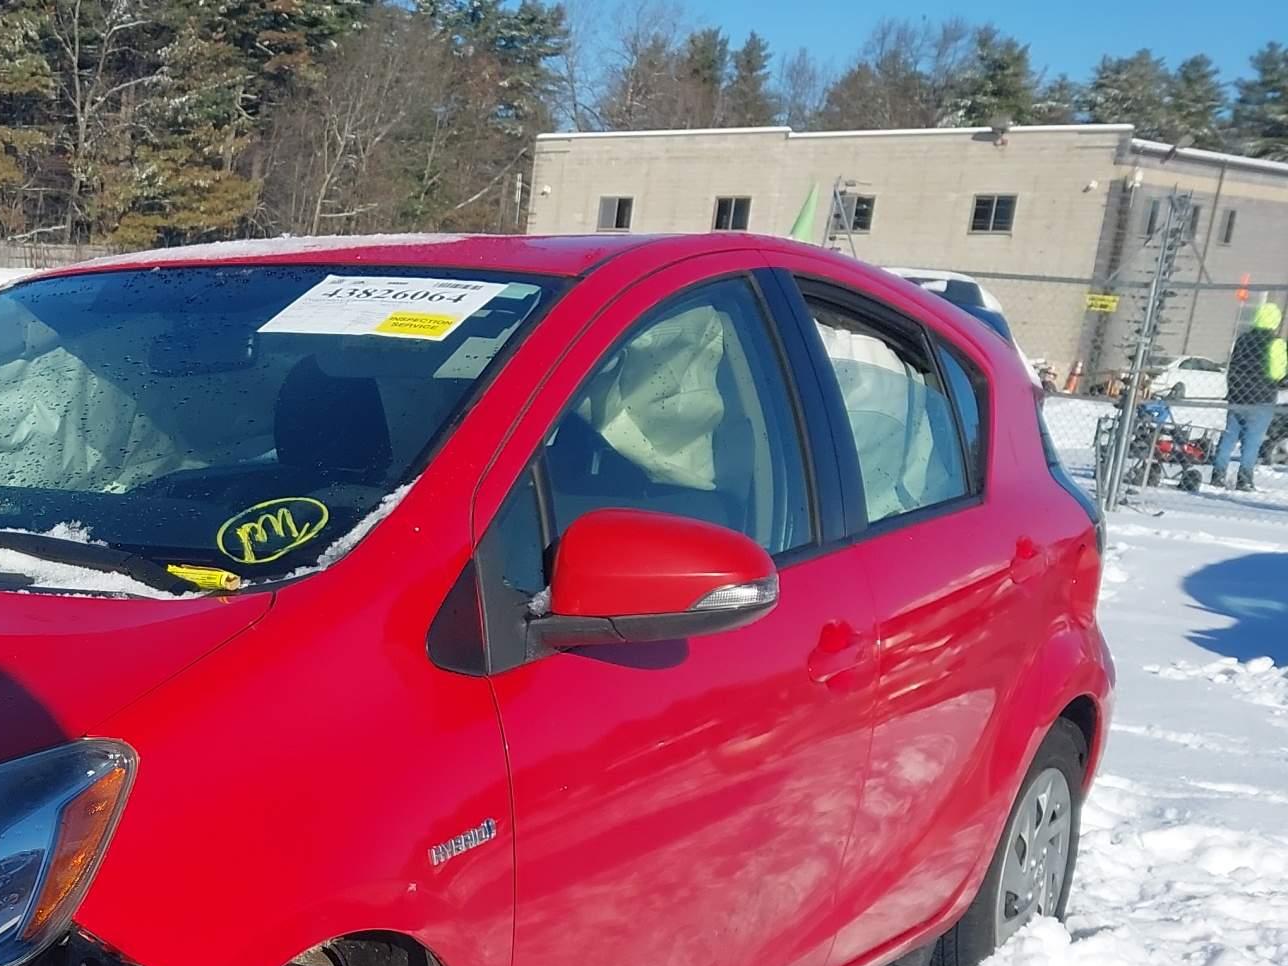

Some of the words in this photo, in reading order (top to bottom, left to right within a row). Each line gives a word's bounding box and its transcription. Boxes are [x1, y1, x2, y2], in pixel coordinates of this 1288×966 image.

[322, 287, 468, 303] 43826064
[389, 316, 453, 325] INSPECTION
[391, 321, 439, 329] SERVICE
[427, 823, 490, 866] HYBRID
